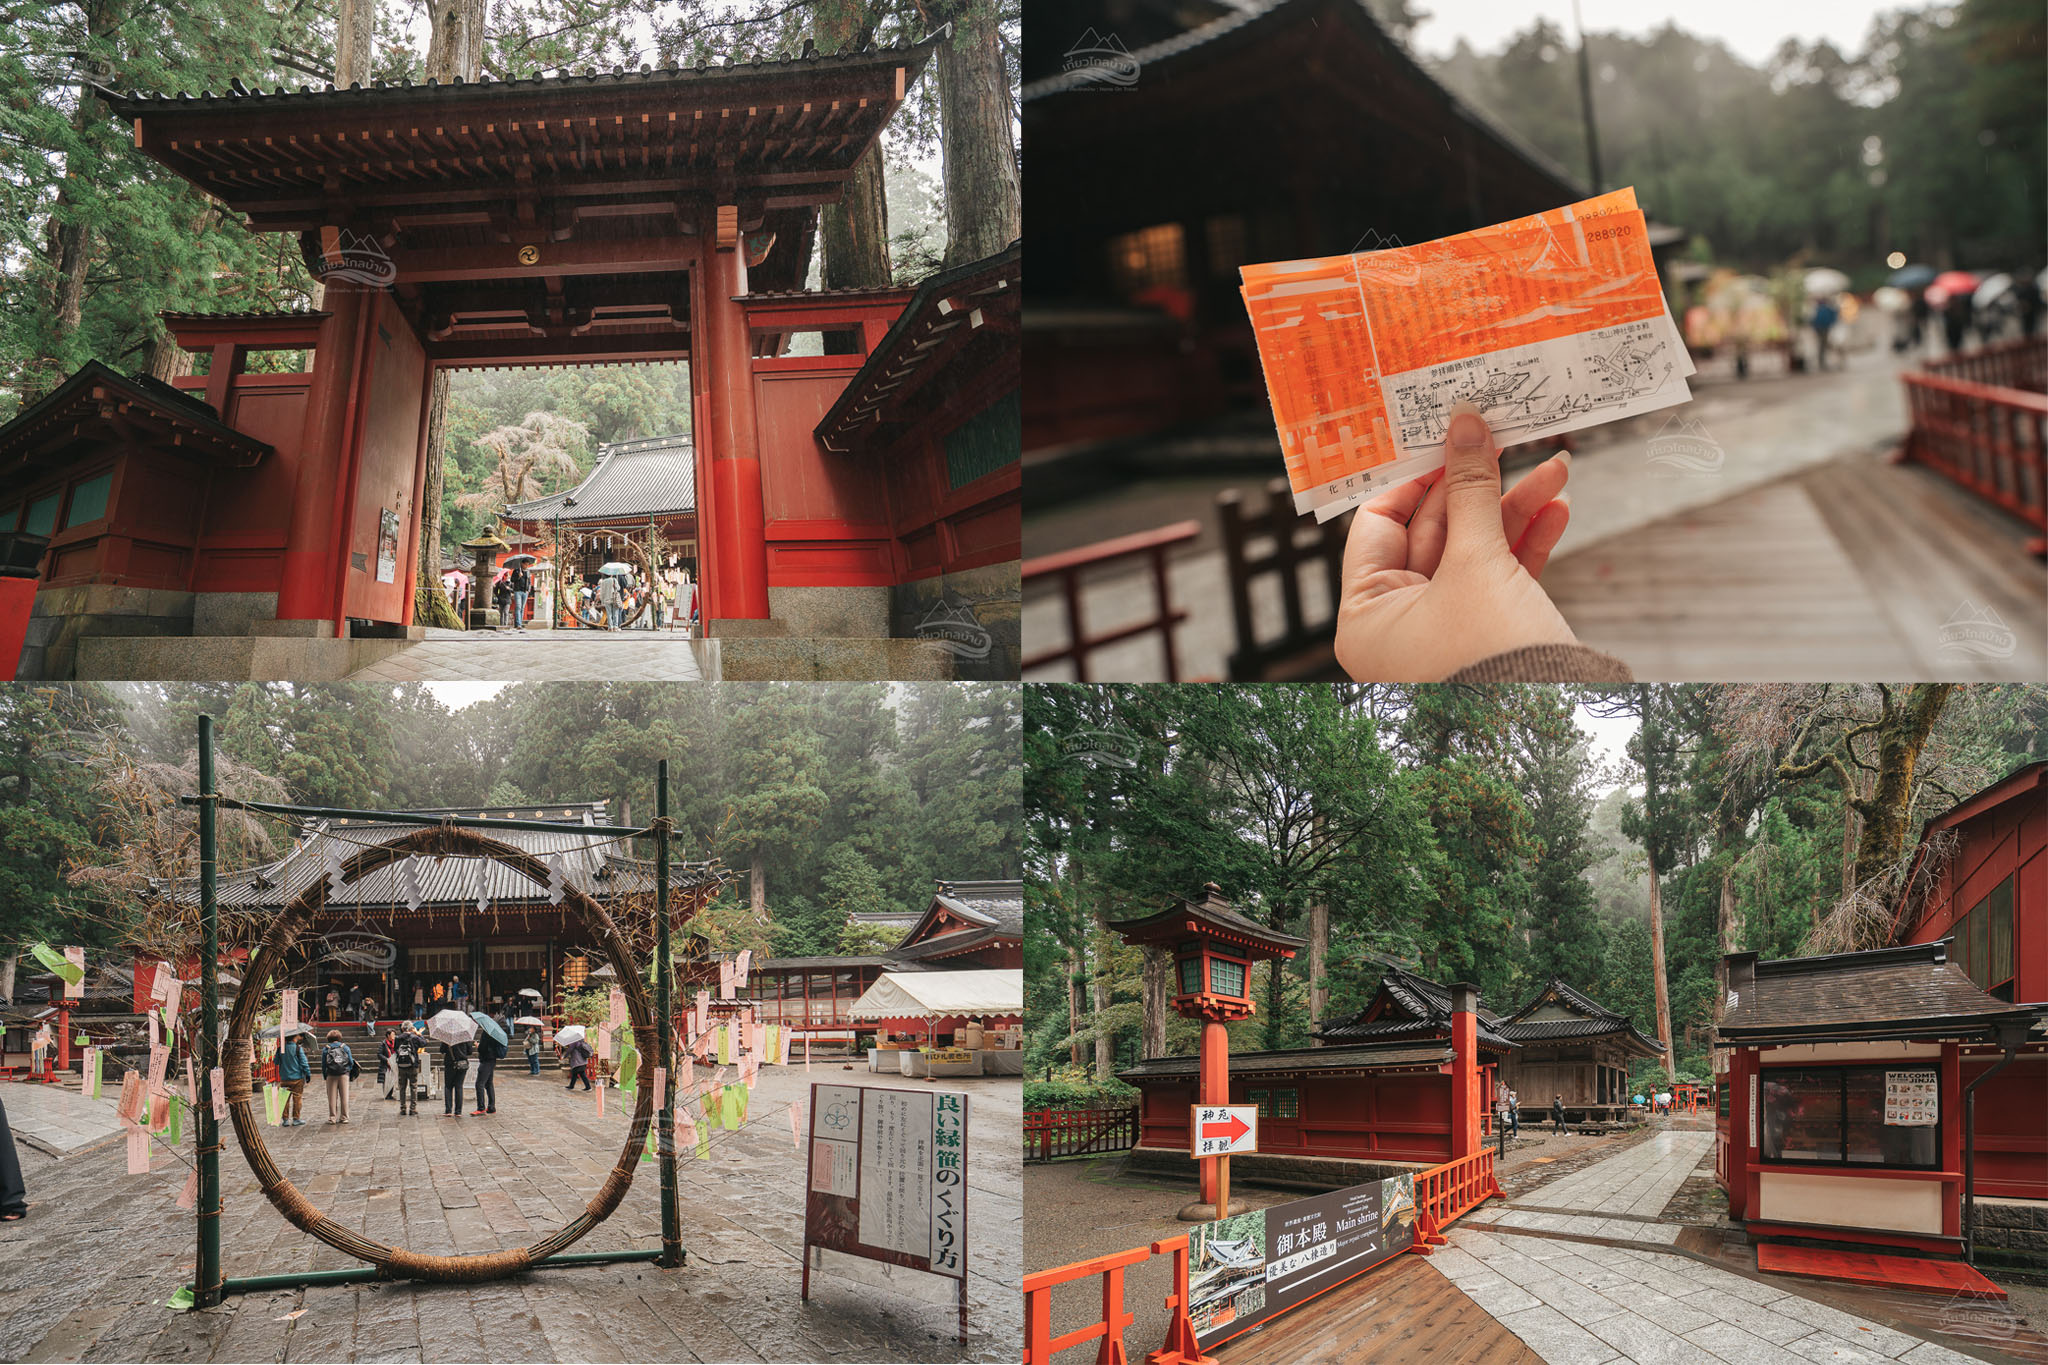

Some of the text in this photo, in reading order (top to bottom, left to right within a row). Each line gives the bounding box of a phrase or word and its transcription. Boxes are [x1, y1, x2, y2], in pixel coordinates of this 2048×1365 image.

[1587, 225, 1631, 243] 288920
[1202, 1108, 1229, 1121] 神苑
[1202, 1139, 1229, 1153] 拝観
[934, 1094, 961, 1270] 良い縁笹のくぐり方
[1336, 1210, 1379, 1233] Main shrine
[1276, 1222, 1327, 1256] 御本殿
